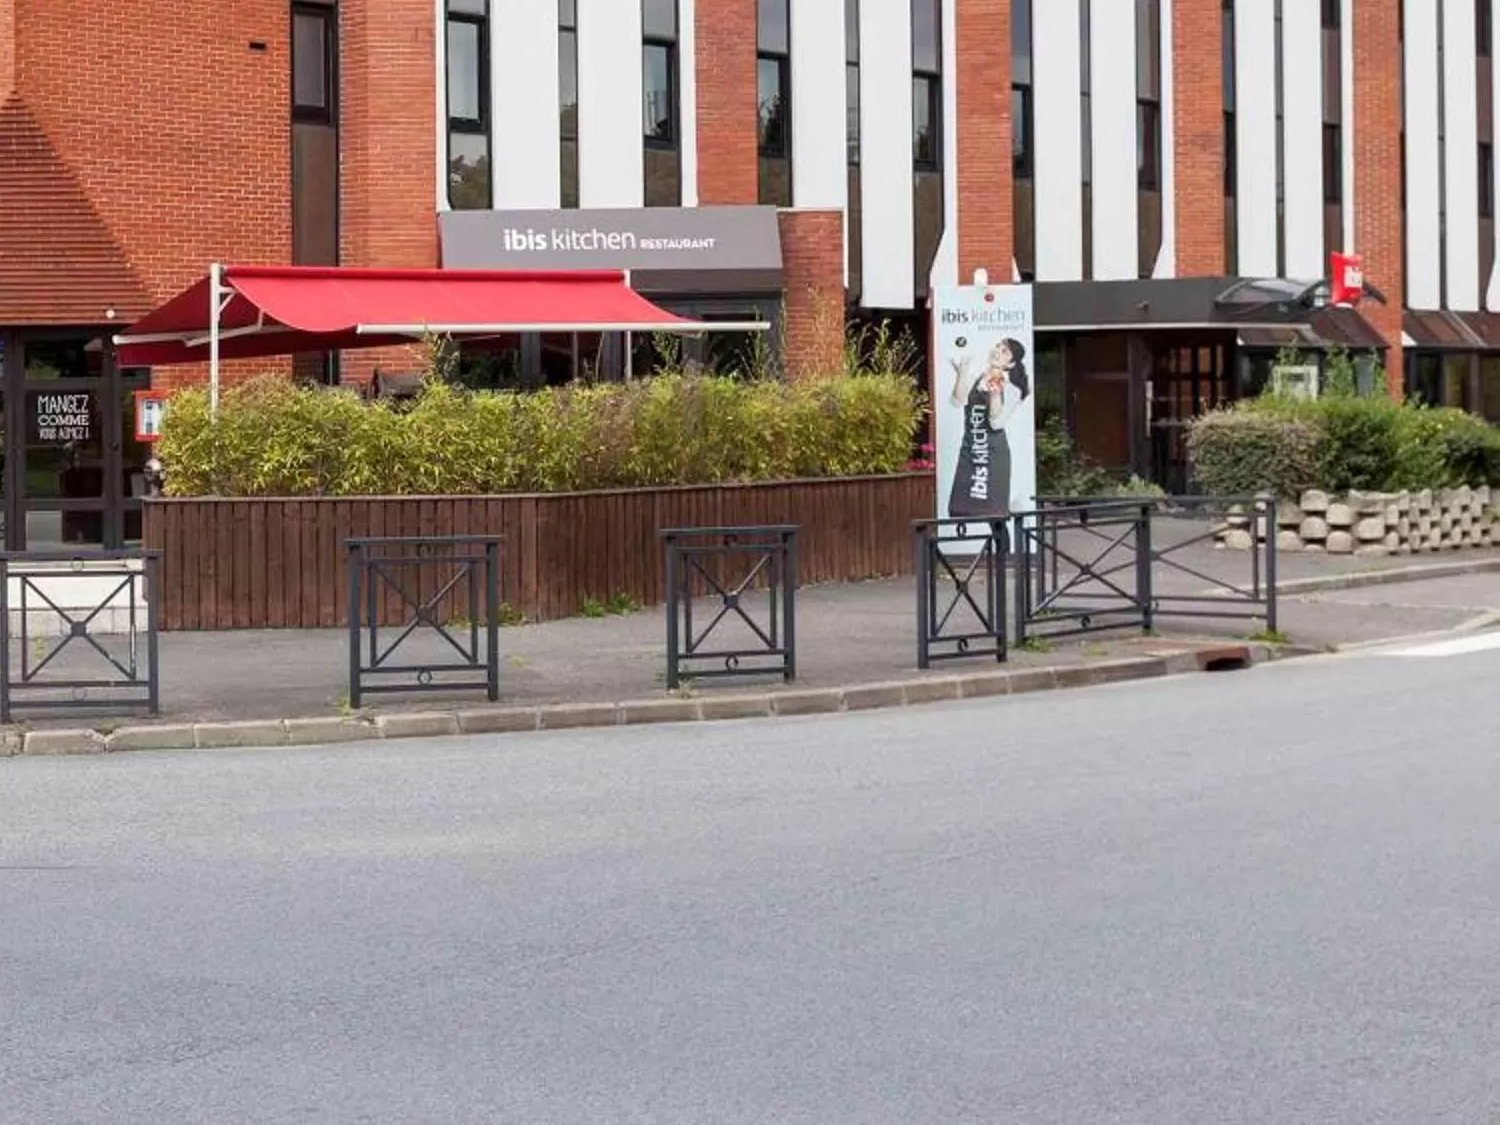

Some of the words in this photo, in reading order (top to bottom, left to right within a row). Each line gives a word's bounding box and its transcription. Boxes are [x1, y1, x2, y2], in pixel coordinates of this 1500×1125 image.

[503, 228, 547, 251] ibis
[551, 227, 637, 251] kitchen
[640, 237, 715, 249] RESTAURANT
[941, 308, 969, 324] ibis
[37, 394, 89, 414] MANGEZ
[37, 415, 90, 426] COMME
[970, 404, 989, 464] kitchen
[970, 466, 988, 500] ibis
